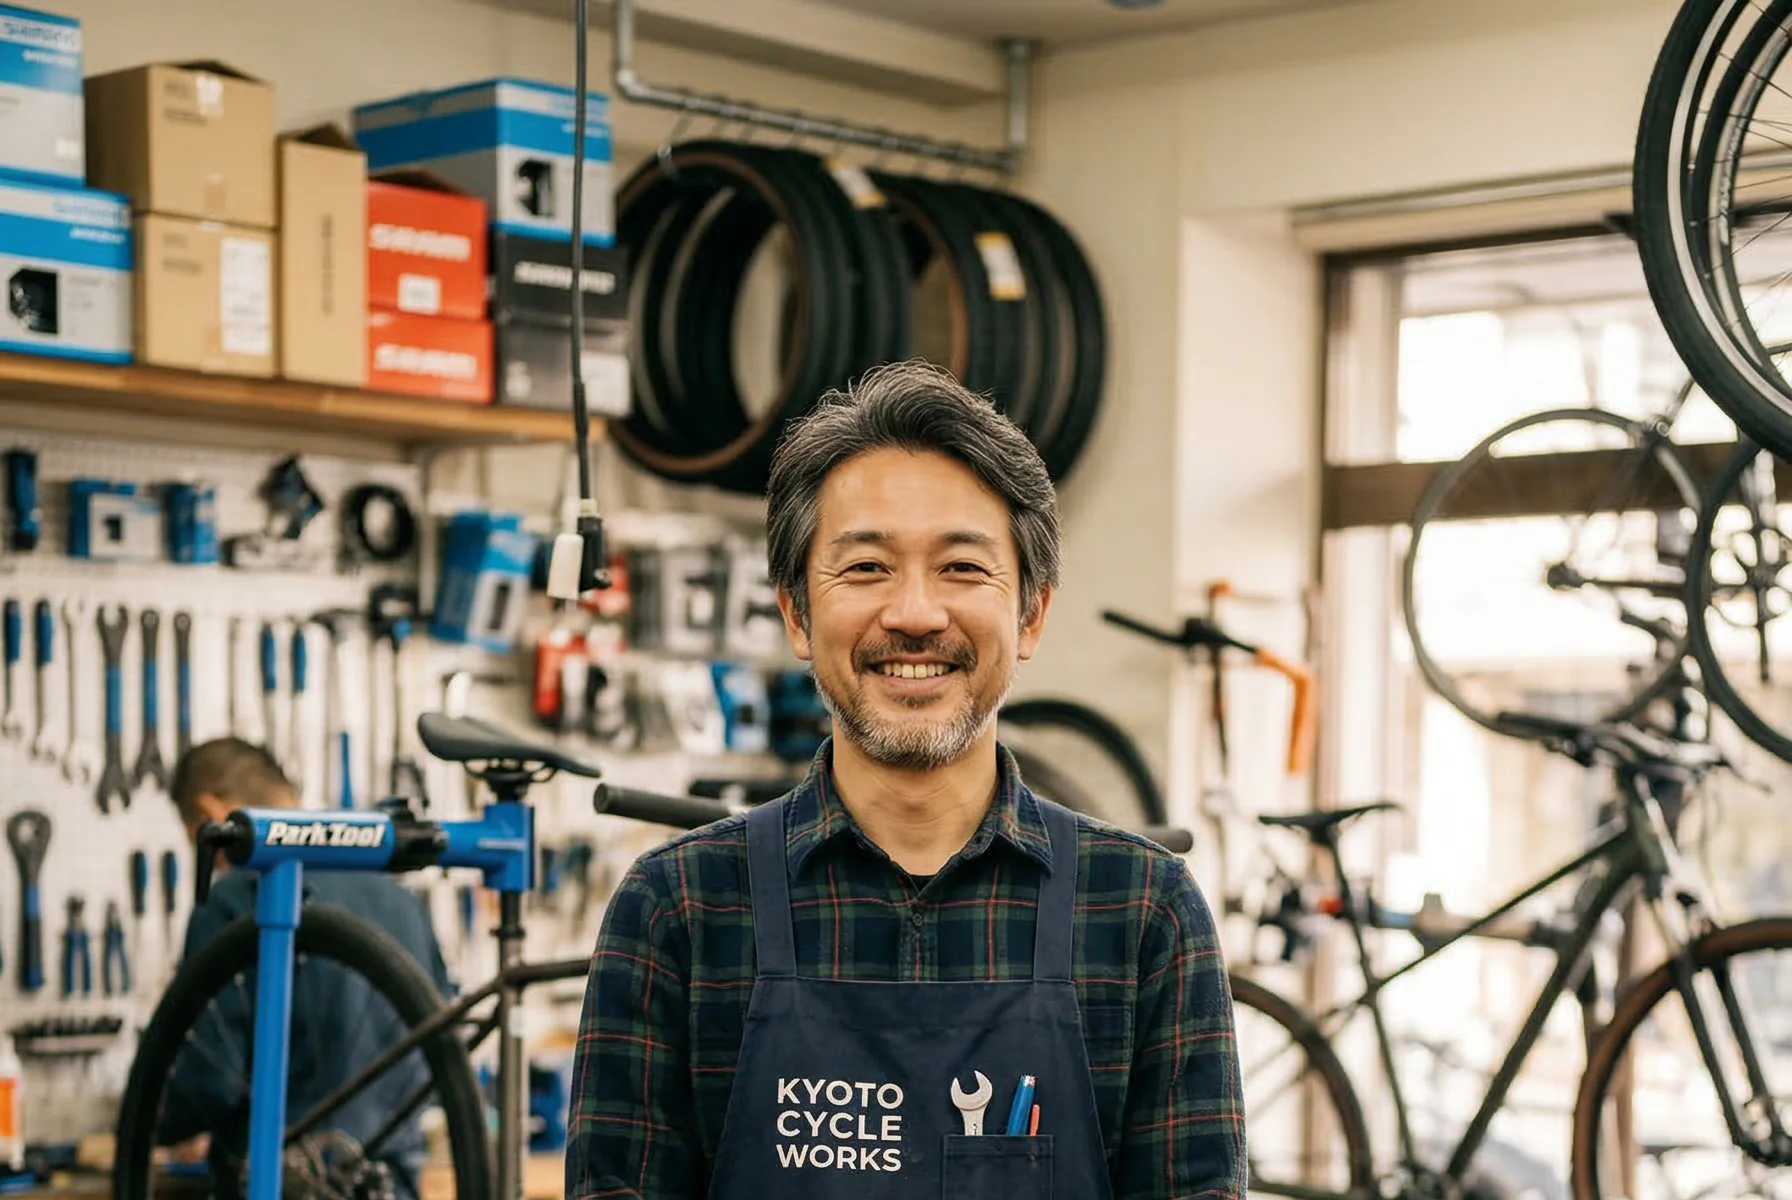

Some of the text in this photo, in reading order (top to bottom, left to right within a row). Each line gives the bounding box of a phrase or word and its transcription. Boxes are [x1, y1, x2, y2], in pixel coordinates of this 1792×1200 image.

[777, 1078, 904, 1110] KYOTO
[776, 1110, 902, 1141] CYCLE
[776, 1144, 902, 1172] WORKS
